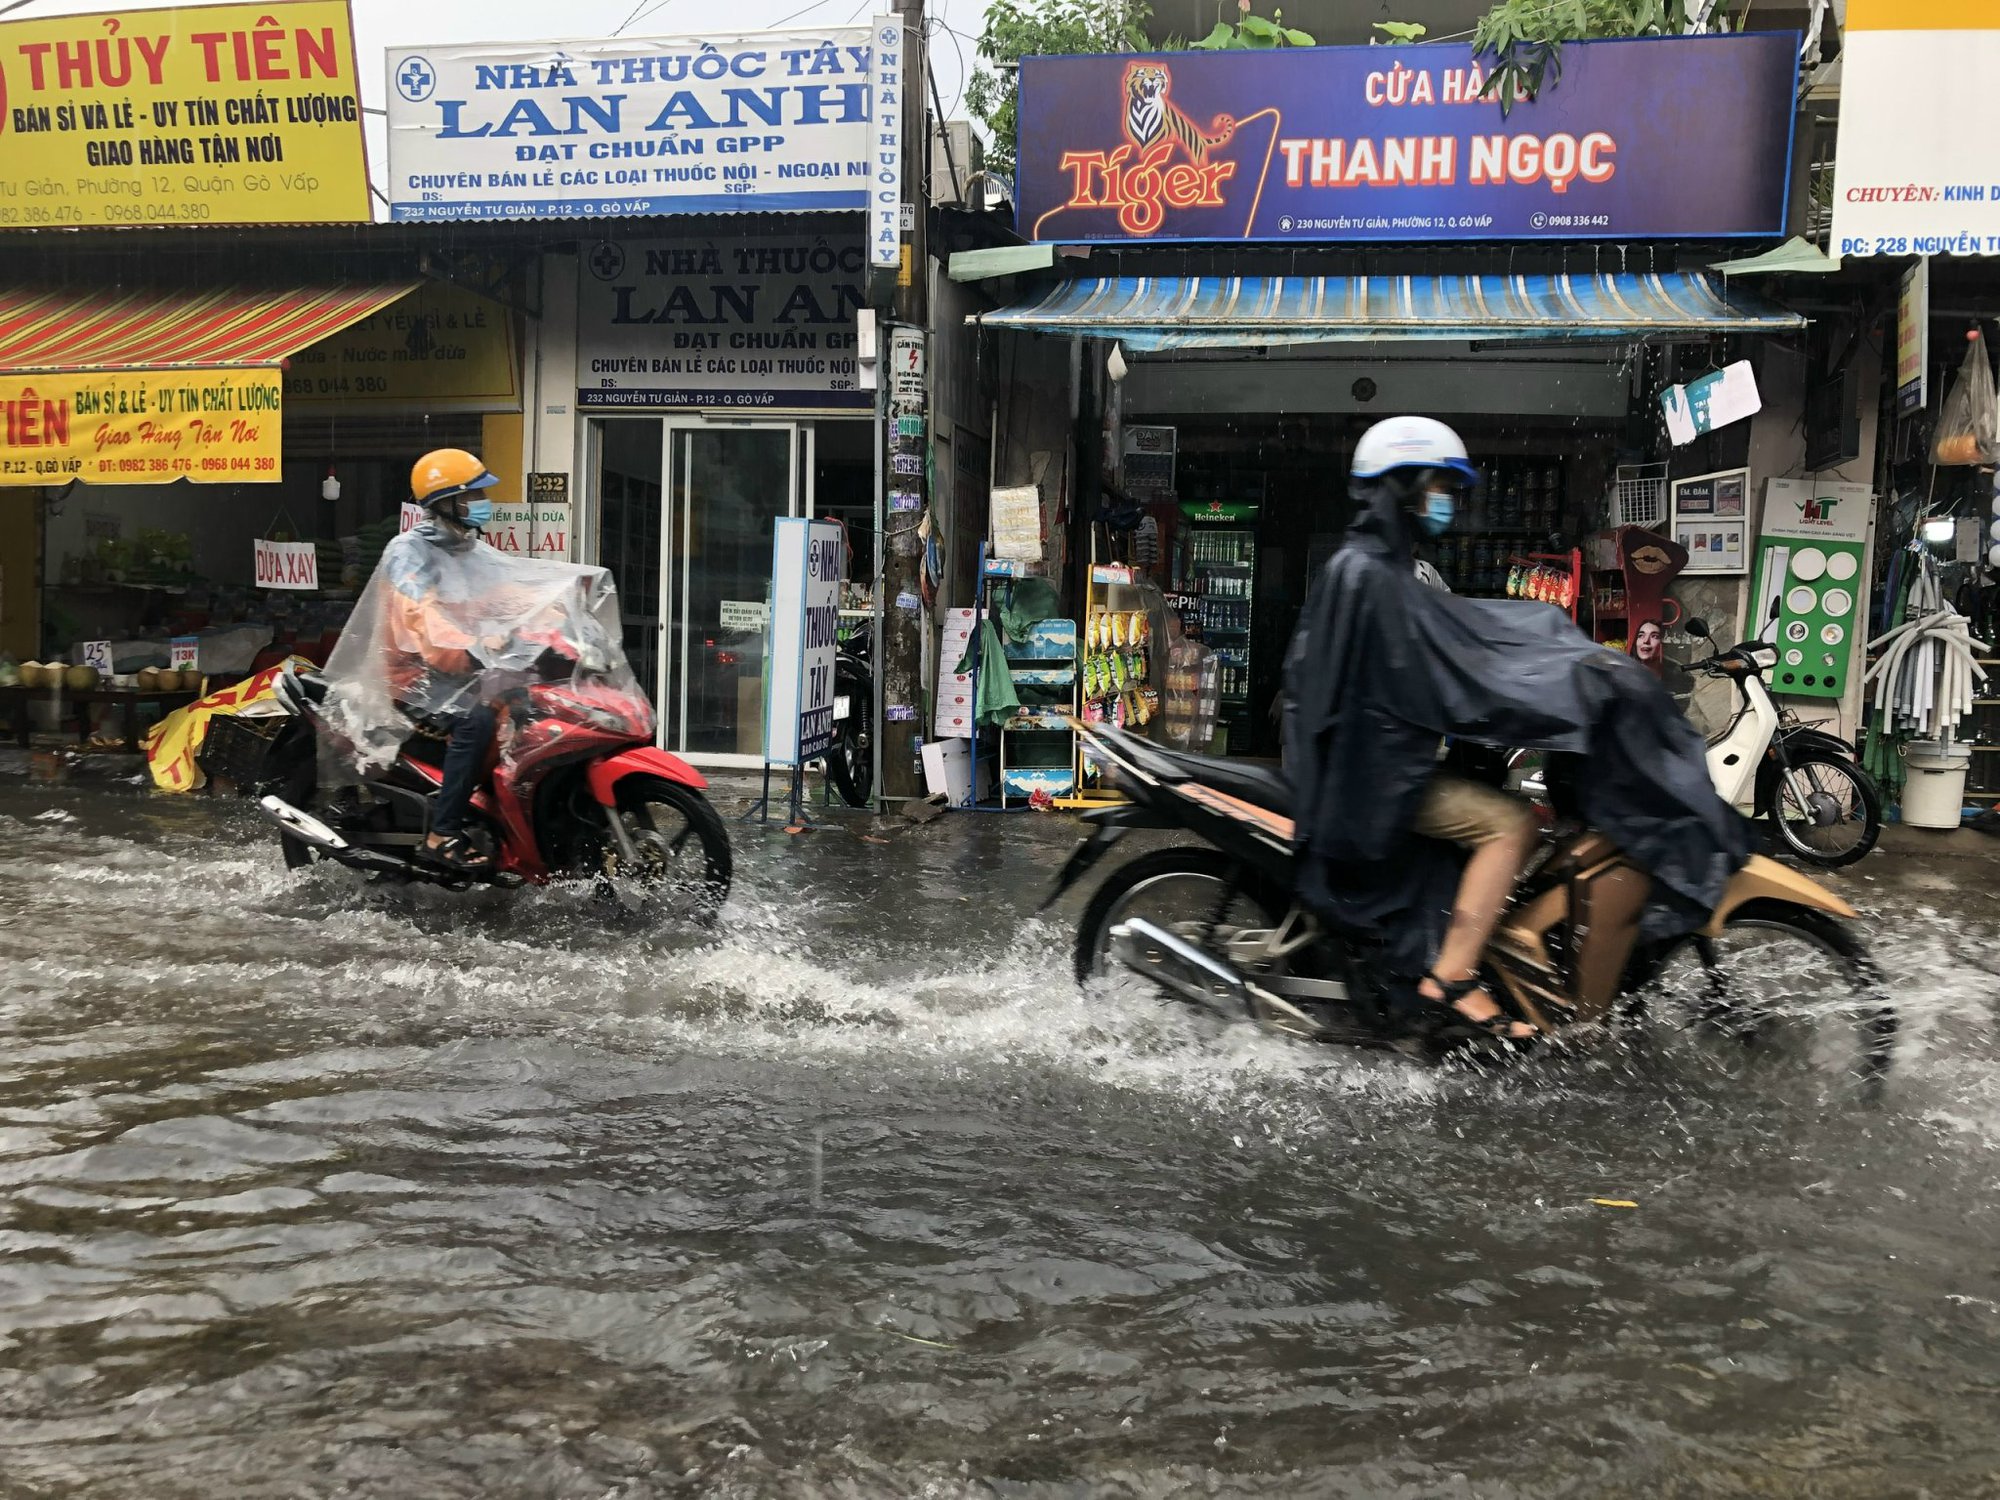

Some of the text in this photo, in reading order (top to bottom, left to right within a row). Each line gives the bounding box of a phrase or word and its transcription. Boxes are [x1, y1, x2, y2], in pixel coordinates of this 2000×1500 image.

[19, 15, 338, 91] THỦY TIÊN
[475, 40, 874, 90] NHÀ THUỐC TÂY
[1366, 60, 1434, 106] CỬA
[12, 89, 358, 133] BÁN SỈ VÀ LẺ UY TÍN CHẤT LƯỢNG
[435, 83, 873, 139] LAN ANH
[86, 133, 283, 168] GIAO HÀNG TẬN NƠI
[515, 133, 785, 164] ĐẠT CHUẨN GPP
[878, 53, 898, 262] NHÀ THUỐC TÂY
[1280, 132, 1617, 193] THANH NGỌC
[151, 177, 176, 194] 12,
[184, 174, 236, 195] Quận
[243, 174, 271, 192] Gò
[280, 171, 319, 193] Vấp
[408, 161, 840, 189] CHUYÊN BÁN LẺ CÁC LOẠI THUỐC NỘI NGOẠI
[724, 183, 756, 193] SGP:
[1060, 143, 1236, 233] Tiger
[422, 192, 443, 201] DS:
[1846, 183, 1984, 202] CHUYÊN: KINH
[0, 203, 210, 224] 82.386.476 0968.044.380
[404, 199, 650, 217] 232 NGUYỄN TƯ GIẢN P.12 Q. GÒ VẤP
[1297, 213, 1609, 230] 230 NGUYỄN TƯ GIẢN, PHƯỜNG 12, Q. GÒ VẤP 0908 336 442
[645, 242, 723, 275] NHÀ
[733, 236, 865, 274] THUỐC
[1842, 230, 1980, 254] ĐC: 228 NGUYỄN
[611, 284, 866, 324] LAN AN
[674, 325, 858, 354] ĐẠT CHUẨN GP
[591, 353, 856, 377] CHUYÊN BÁN LẺ CÁC LOẠI THUỐC NỘI
[76, 377, 280, 416] BÁN SỈ & LẺ UY TÍN CHẤT LƯỢNG
[356, 376, 388, 393] 380
[587, 393, 603, 403] 232
[605, 390, 647, 403] NGUYỄN
[664, 391, 688, 404] GIẢN
[696, 394, 715, 404] P.12
[723, 394, 735, 405] Q.
[737, 391, 753, 404] GÒ
[755, 392, 774, 404] VẤP
[601, 378, 617, 388] DS:
[830, 379, 855, 390] SGP:
[0, 387, 70, 447] IÊN
[93, 419, 259, 452] Giao Hàng Tận Nơi
[4, 461, 26, 474] P.12
[62, 456, 82, 474] VẤP
[99, 460, 117, 472] ĐT:
[119, 458, 146, 472] 0982
[149, 458, 169, 472] 386
[171, 458, 192, 471] 476
[201, 457, 228, 471] 0968
[230, 457, 251, 470] 044
[254, 456, 275, 470] 380
[532, 477, 564, 492] 232
[489, 506, 565, 522] IỂM BÁN DỪA
[1194, 513, 1235, 522] Heineken
[486, 527, 565, 551] MÃ LAI
[288, 552, 314, 584] XAY
[820, 530, 839, 582] NHÀ
[806, 591, 837, 649] THUỐC
[175, 649, 195, 661] 13K
[810, 656, 828, 708] TÂY
[801, 708, 832, 741] LAN ANH
